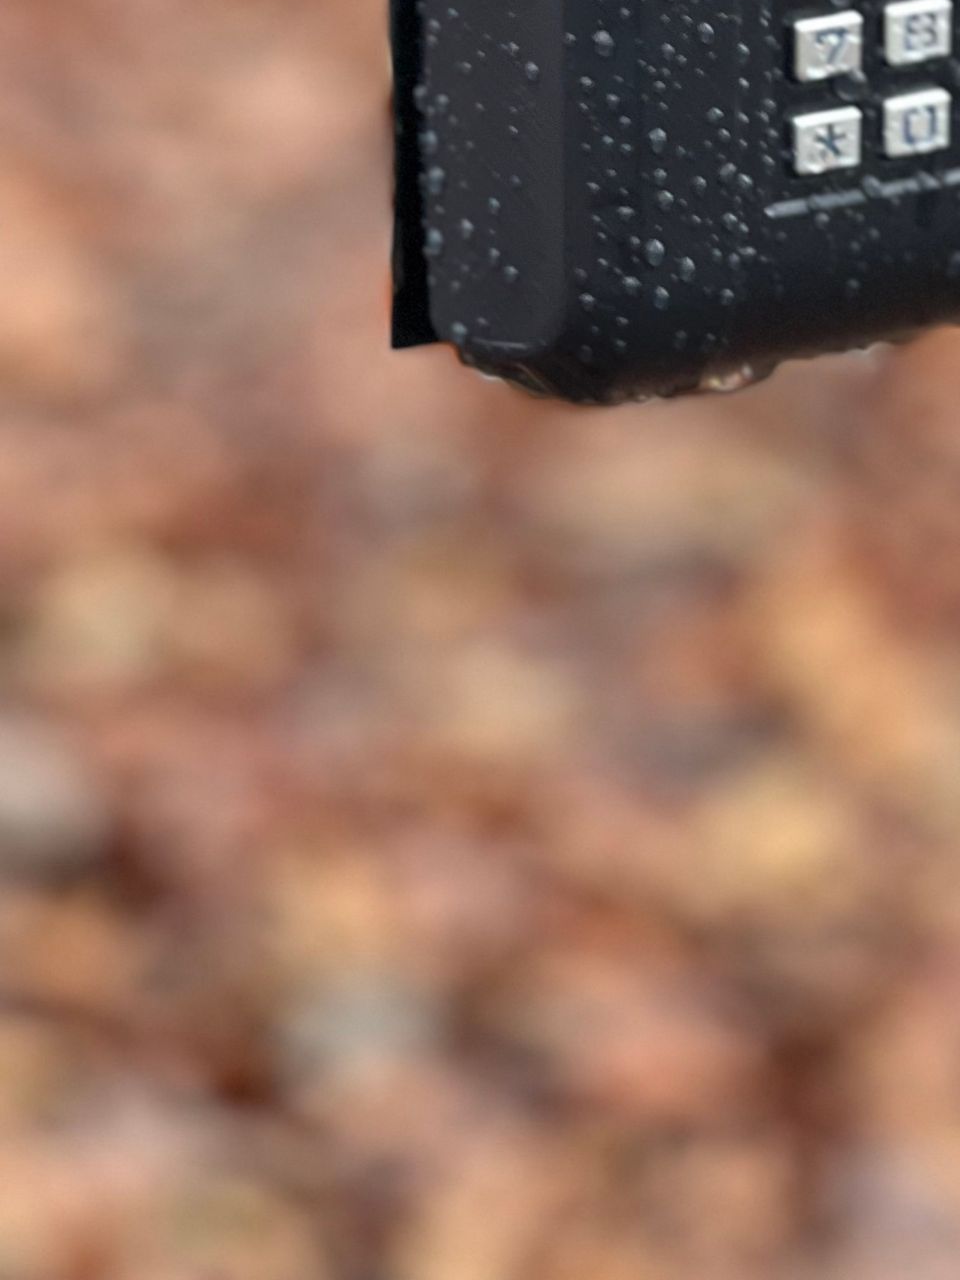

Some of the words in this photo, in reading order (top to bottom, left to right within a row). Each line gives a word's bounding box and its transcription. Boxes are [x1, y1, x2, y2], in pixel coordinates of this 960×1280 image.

[816, 27, 848, 65] 7
[904, 12, 938, 51] 8
[903, 104, 938, 146] 0
